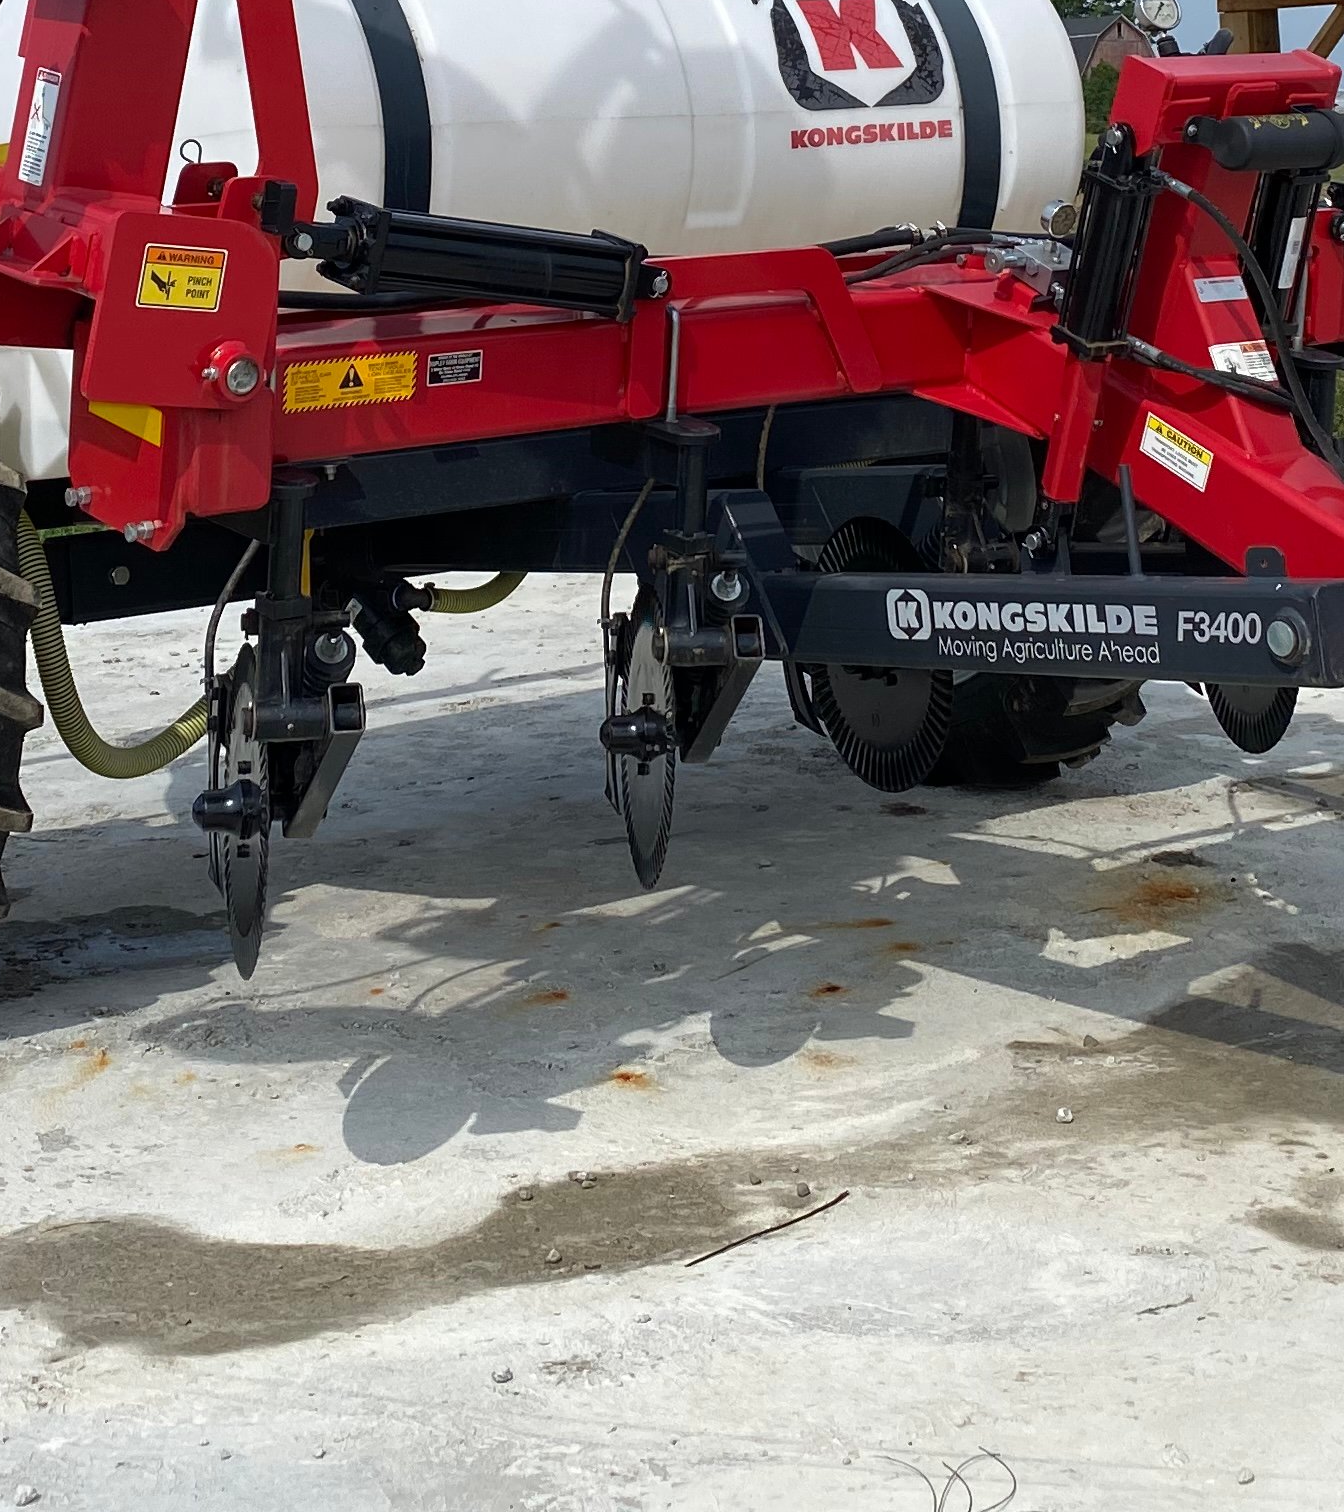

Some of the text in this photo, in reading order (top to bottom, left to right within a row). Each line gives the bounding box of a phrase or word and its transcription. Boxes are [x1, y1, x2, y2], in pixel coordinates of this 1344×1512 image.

[790, 119, 953, 150] KONGSKILDE
[169, 252, 215, 265] WARNING
[185, 289, 210, 300] POINT
[187, 276, 212, 286] PINCH
[1166, 429, 1204, 459] CAUTION
[896, 600, 1262, 645] K KONGSKILDE F3400
[938, 635, 1161, 664] Moving Agriculture Ahead
